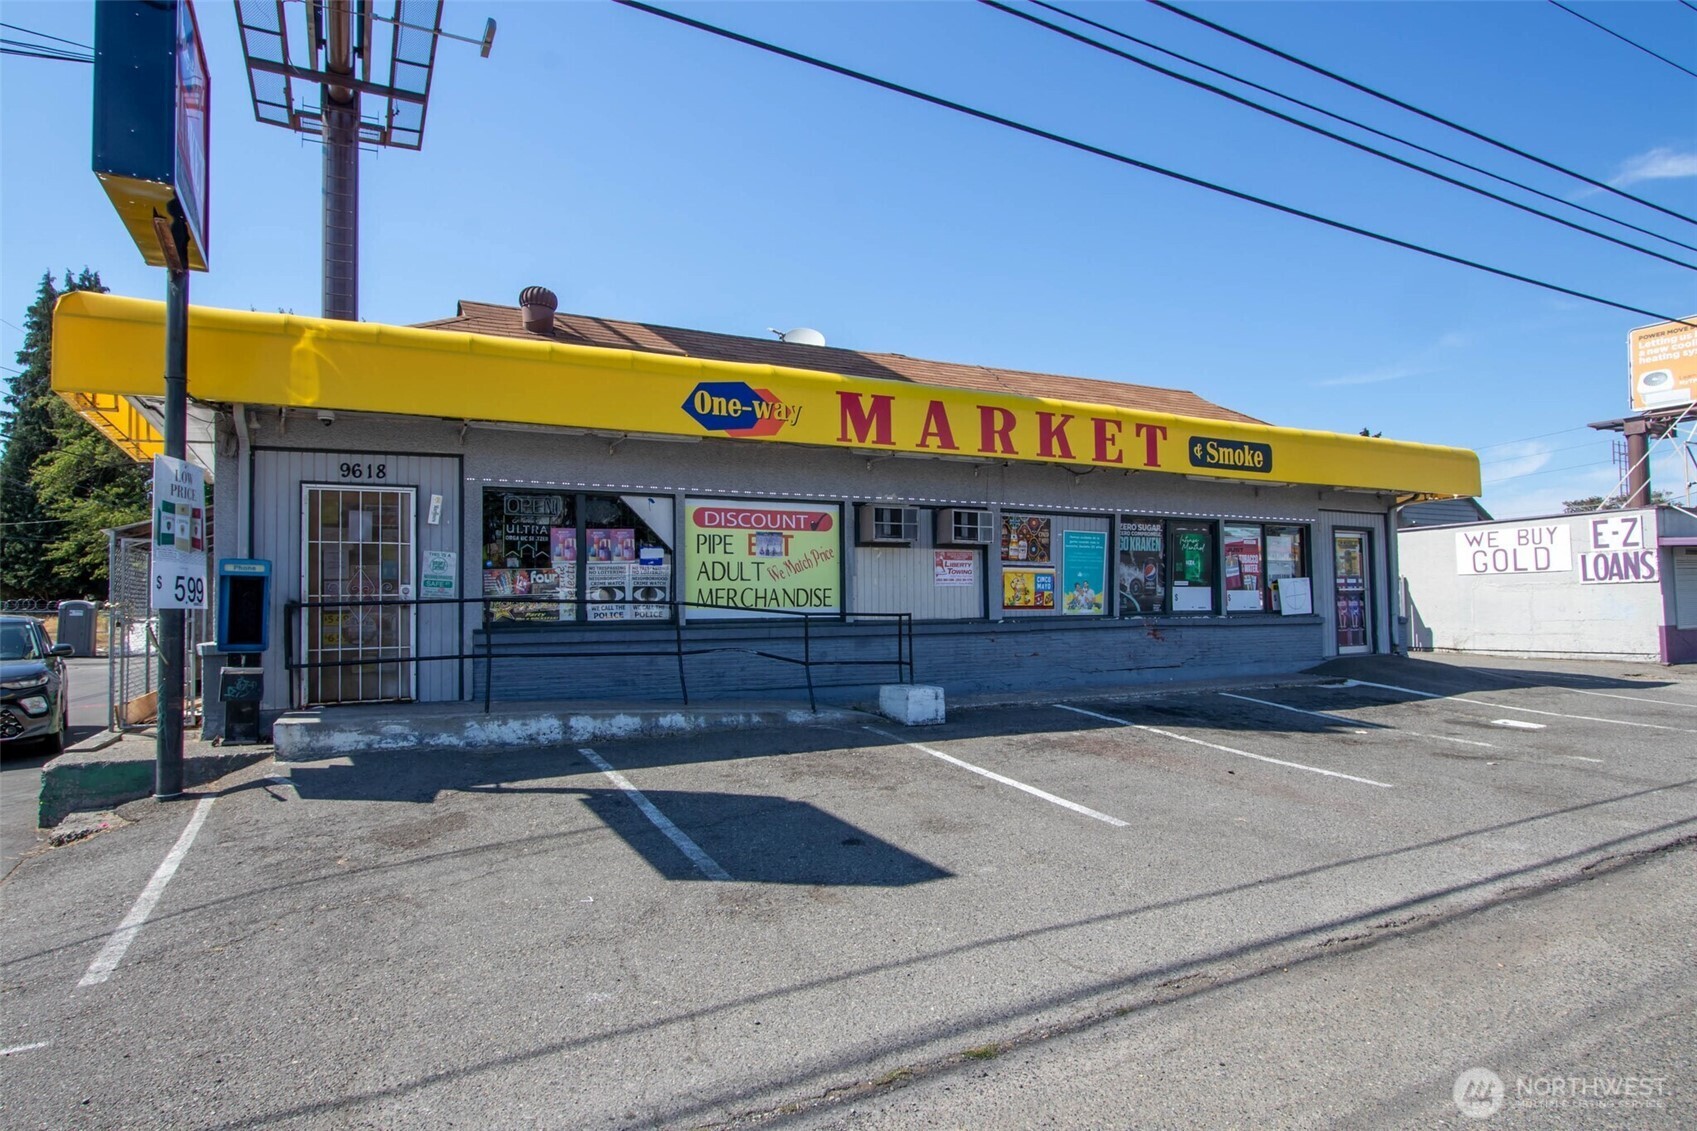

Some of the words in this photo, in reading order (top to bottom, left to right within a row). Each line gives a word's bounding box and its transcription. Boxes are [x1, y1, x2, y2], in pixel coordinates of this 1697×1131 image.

[1639, 331, 1665, 341] POWER
[1667, 326, 1688, 335] MOVE
[1639, 336, 1677, 349] Letting
[1680, 332, 1692, 341] us
[1639, 351, 1680, 365] heating
[1647, 346, 1669, 355] new
[694, 390, 802, 427] One-way
[836, 391, 1167, 468] MARKET
[1206, 441, 1264, 468] Smoke
[175, 469, 193, 485] LOW
[339, 462, 387, 479] 9618
[170, 483, 197, 501] PRICE
[704, 511, 808, 529] DISCOUNT
[1120, 523, 1137, 531] ZERO
[506, 524, 548, 535] ULTRA
[1464, 531, 1499, 548] WE
[1517, 526, 1558, 546] BUY
[1592, 517, 1639, 549] E-Z
[696, 534, 734, 555] PIPE
[1120, 537, 1129, 551] GO
[1130, 537, 1161, 551] KRAKEN
[767, 565, 785, 582] We
[784, 554, 813, 577] Match
[810, 546, 835, 567] Price
[1472, 546, 1551, 574] GOLD
[1581, 550, 1656, 582] LOANS
[531, 570, 557, 583] four
[697, 561, 765, 582] ADULT
[696, 587, 832, 608] MERCHANDISE
